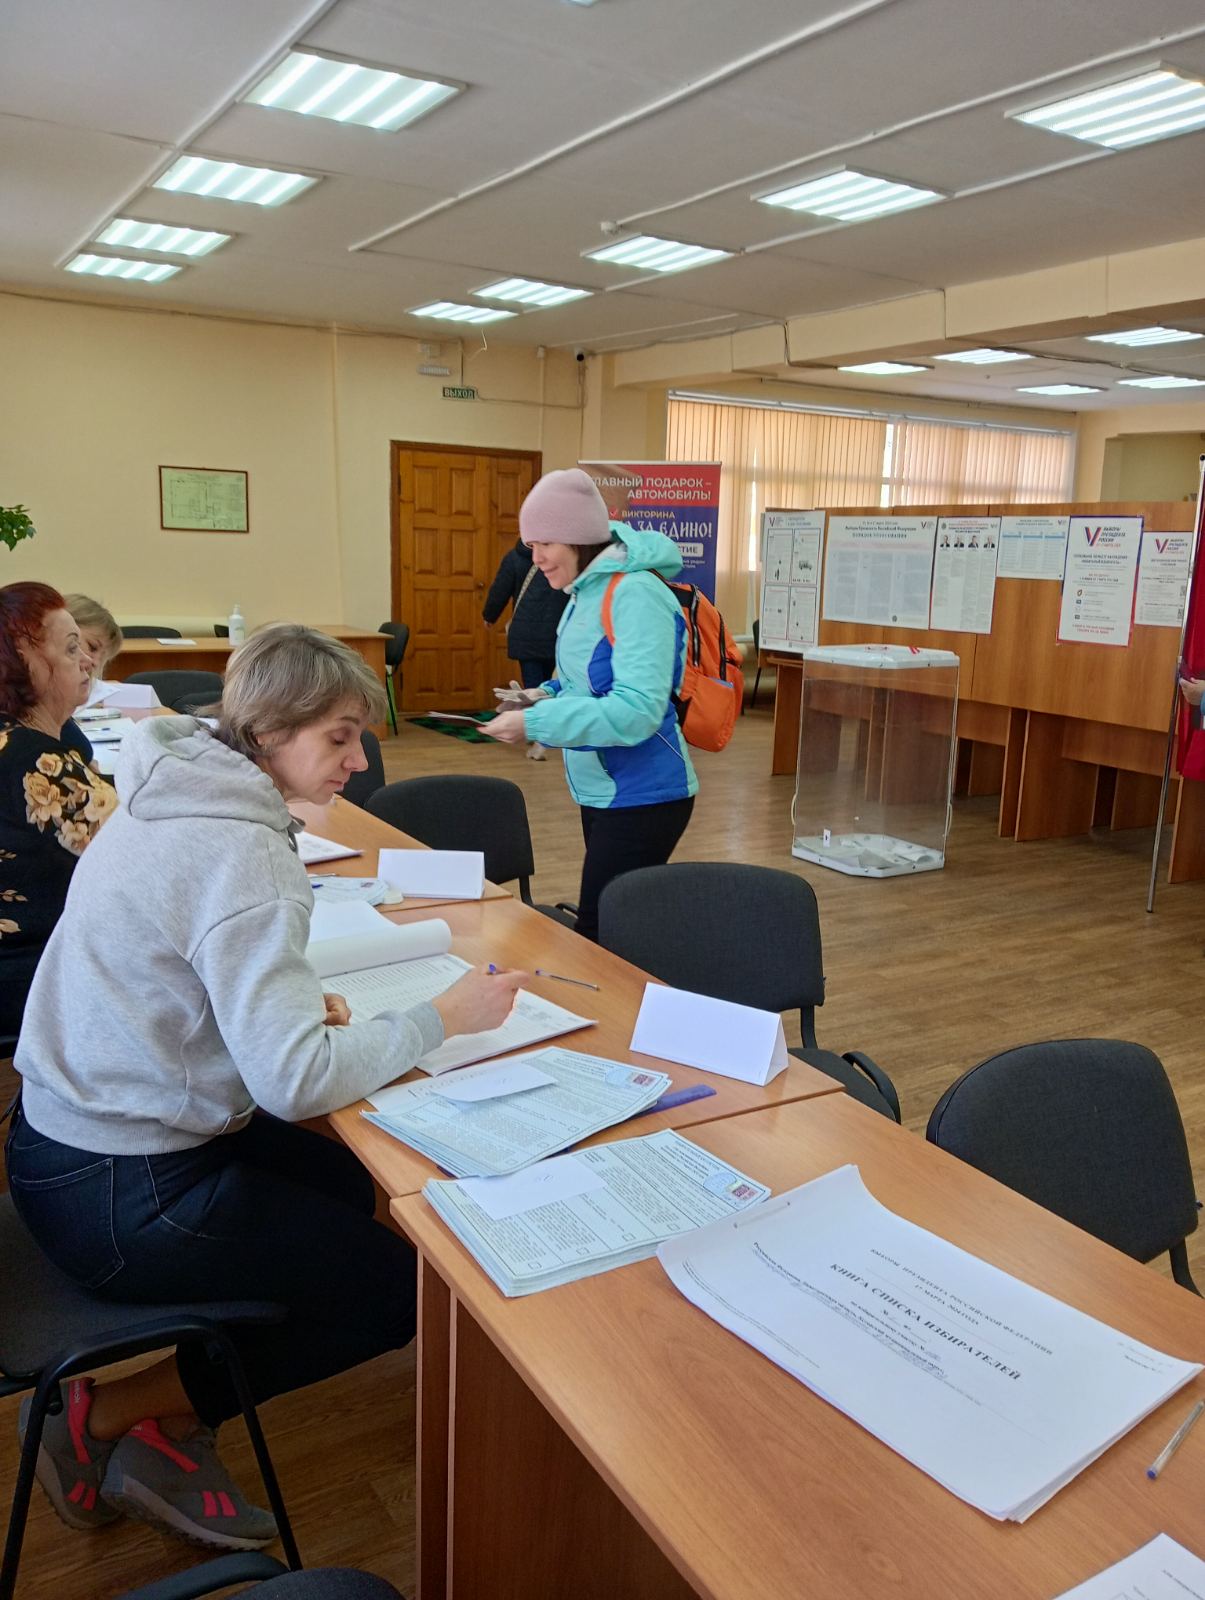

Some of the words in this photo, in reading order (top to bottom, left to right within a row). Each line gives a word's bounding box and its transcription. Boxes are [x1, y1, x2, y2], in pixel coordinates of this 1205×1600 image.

[445, 388, 474, 399] ВЫХОД
[594, 476, 643, 487] ЛАВНЫЙ
[646, 477, 703, 488] ПОДАРОК
[627, 489, 711, 500] АВТОМОБИЛЬ!
[622, 510, 675, 519] ВИКТОРИНА
[830, 1263, 868, 1288] КНИГА
[871, 1287, 920, 1322] СПИСКА
[923, 1320, 1021, 1381] ИЗБИРАТЕЛЕЙ
